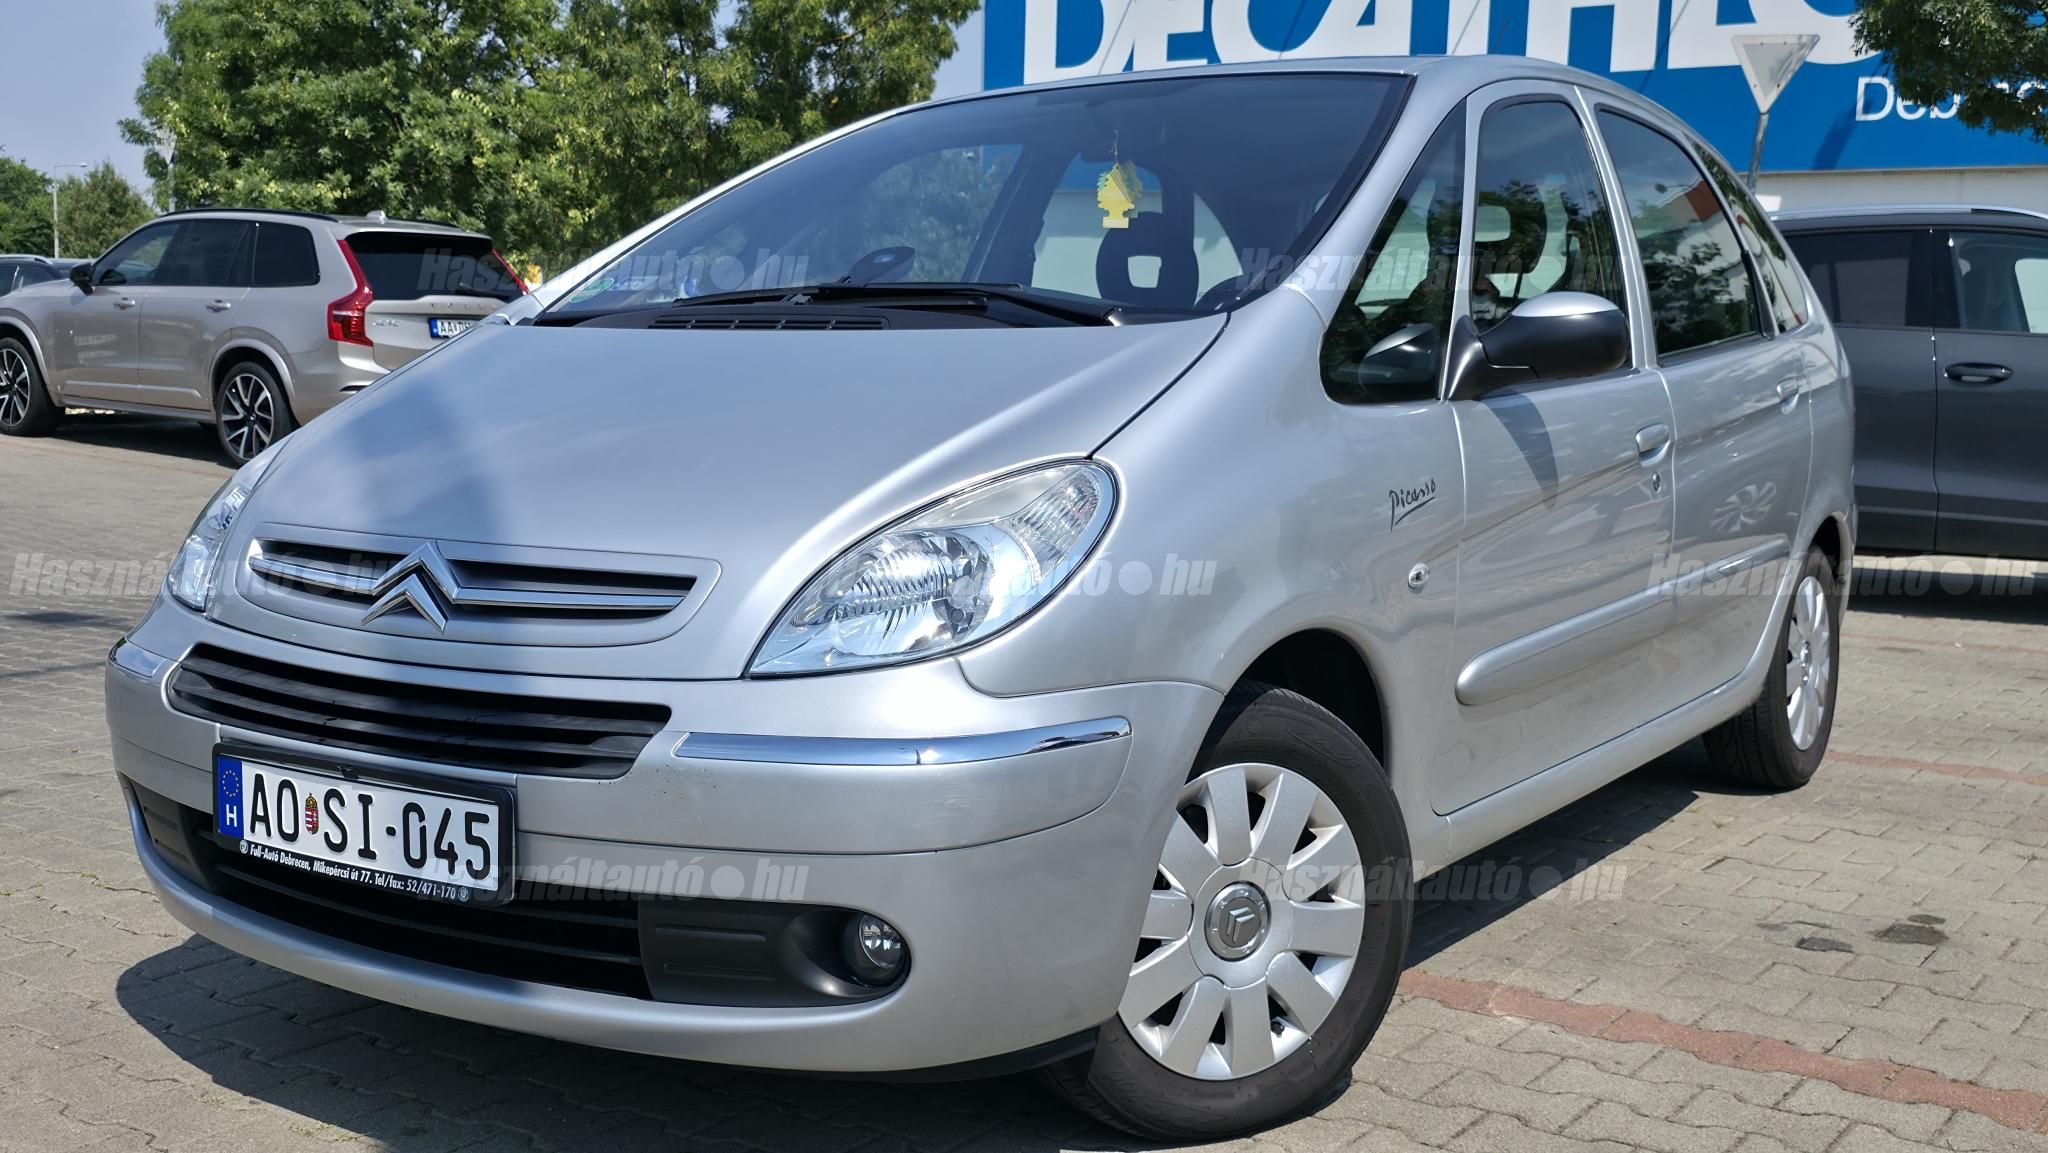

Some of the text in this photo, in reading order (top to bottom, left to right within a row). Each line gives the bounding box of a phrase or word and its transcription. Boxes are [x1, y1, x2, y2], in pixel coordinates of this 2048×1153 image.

[1389, 478, 1436, 531] Picasso
[226, 804, 238, 828] H
[249, 773, 300, 843] AO
[280, 852, 311, 871] Debrecen,
[313, 860, 350, 879] Mikepércsi
[360, 870, 373, 884] 77.
[374, 873, 404, 891] Tel/fax:
[406, 879, 456, 900] 52/471-170
